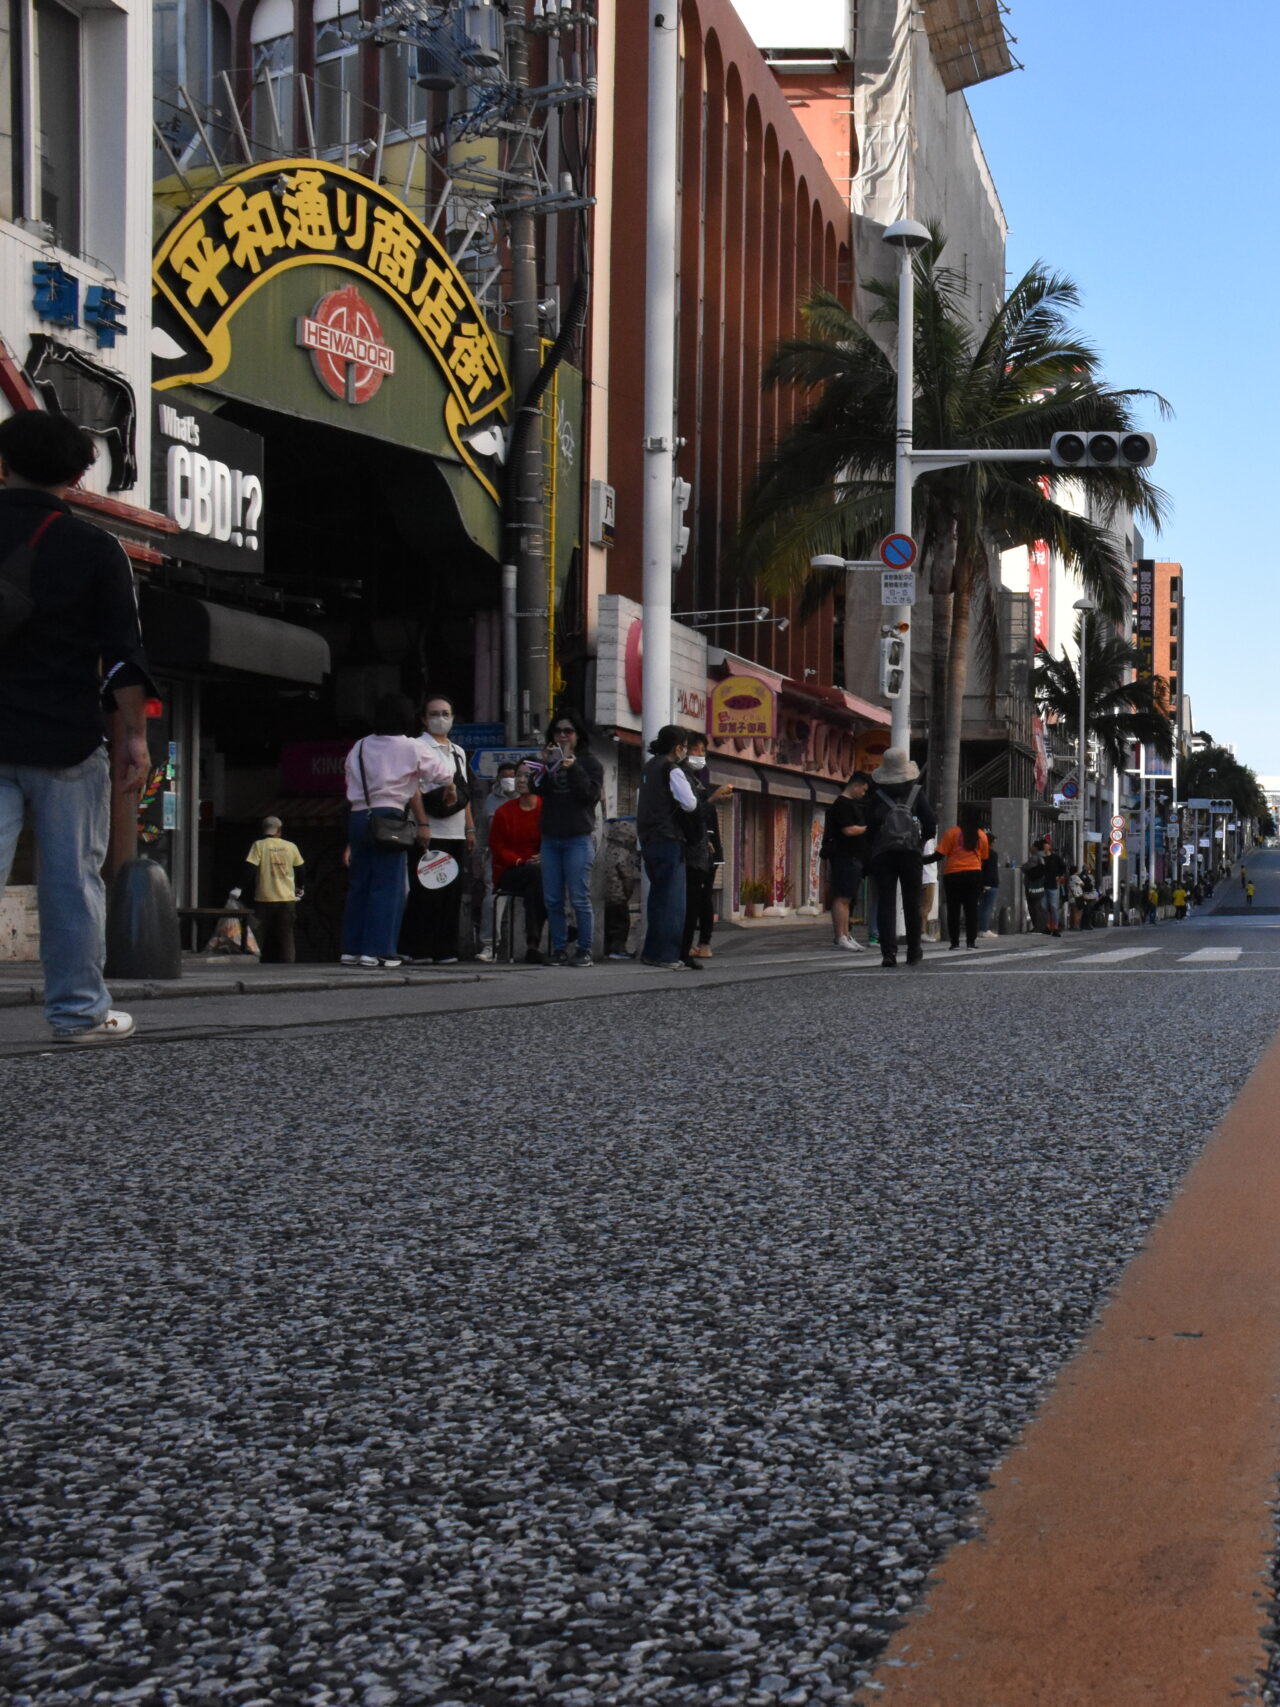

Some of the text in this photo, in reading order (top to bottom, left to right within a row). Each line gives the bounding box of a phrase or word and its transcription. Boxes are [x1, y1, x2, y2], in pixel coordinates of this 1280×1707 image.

[171, 170, 498, 402] 平和通り商店街
[308, 323, 391, 371] HEIWADORI
[159, 404, 200, 446] What's
[167, 445, 263, 551] CBD!?
